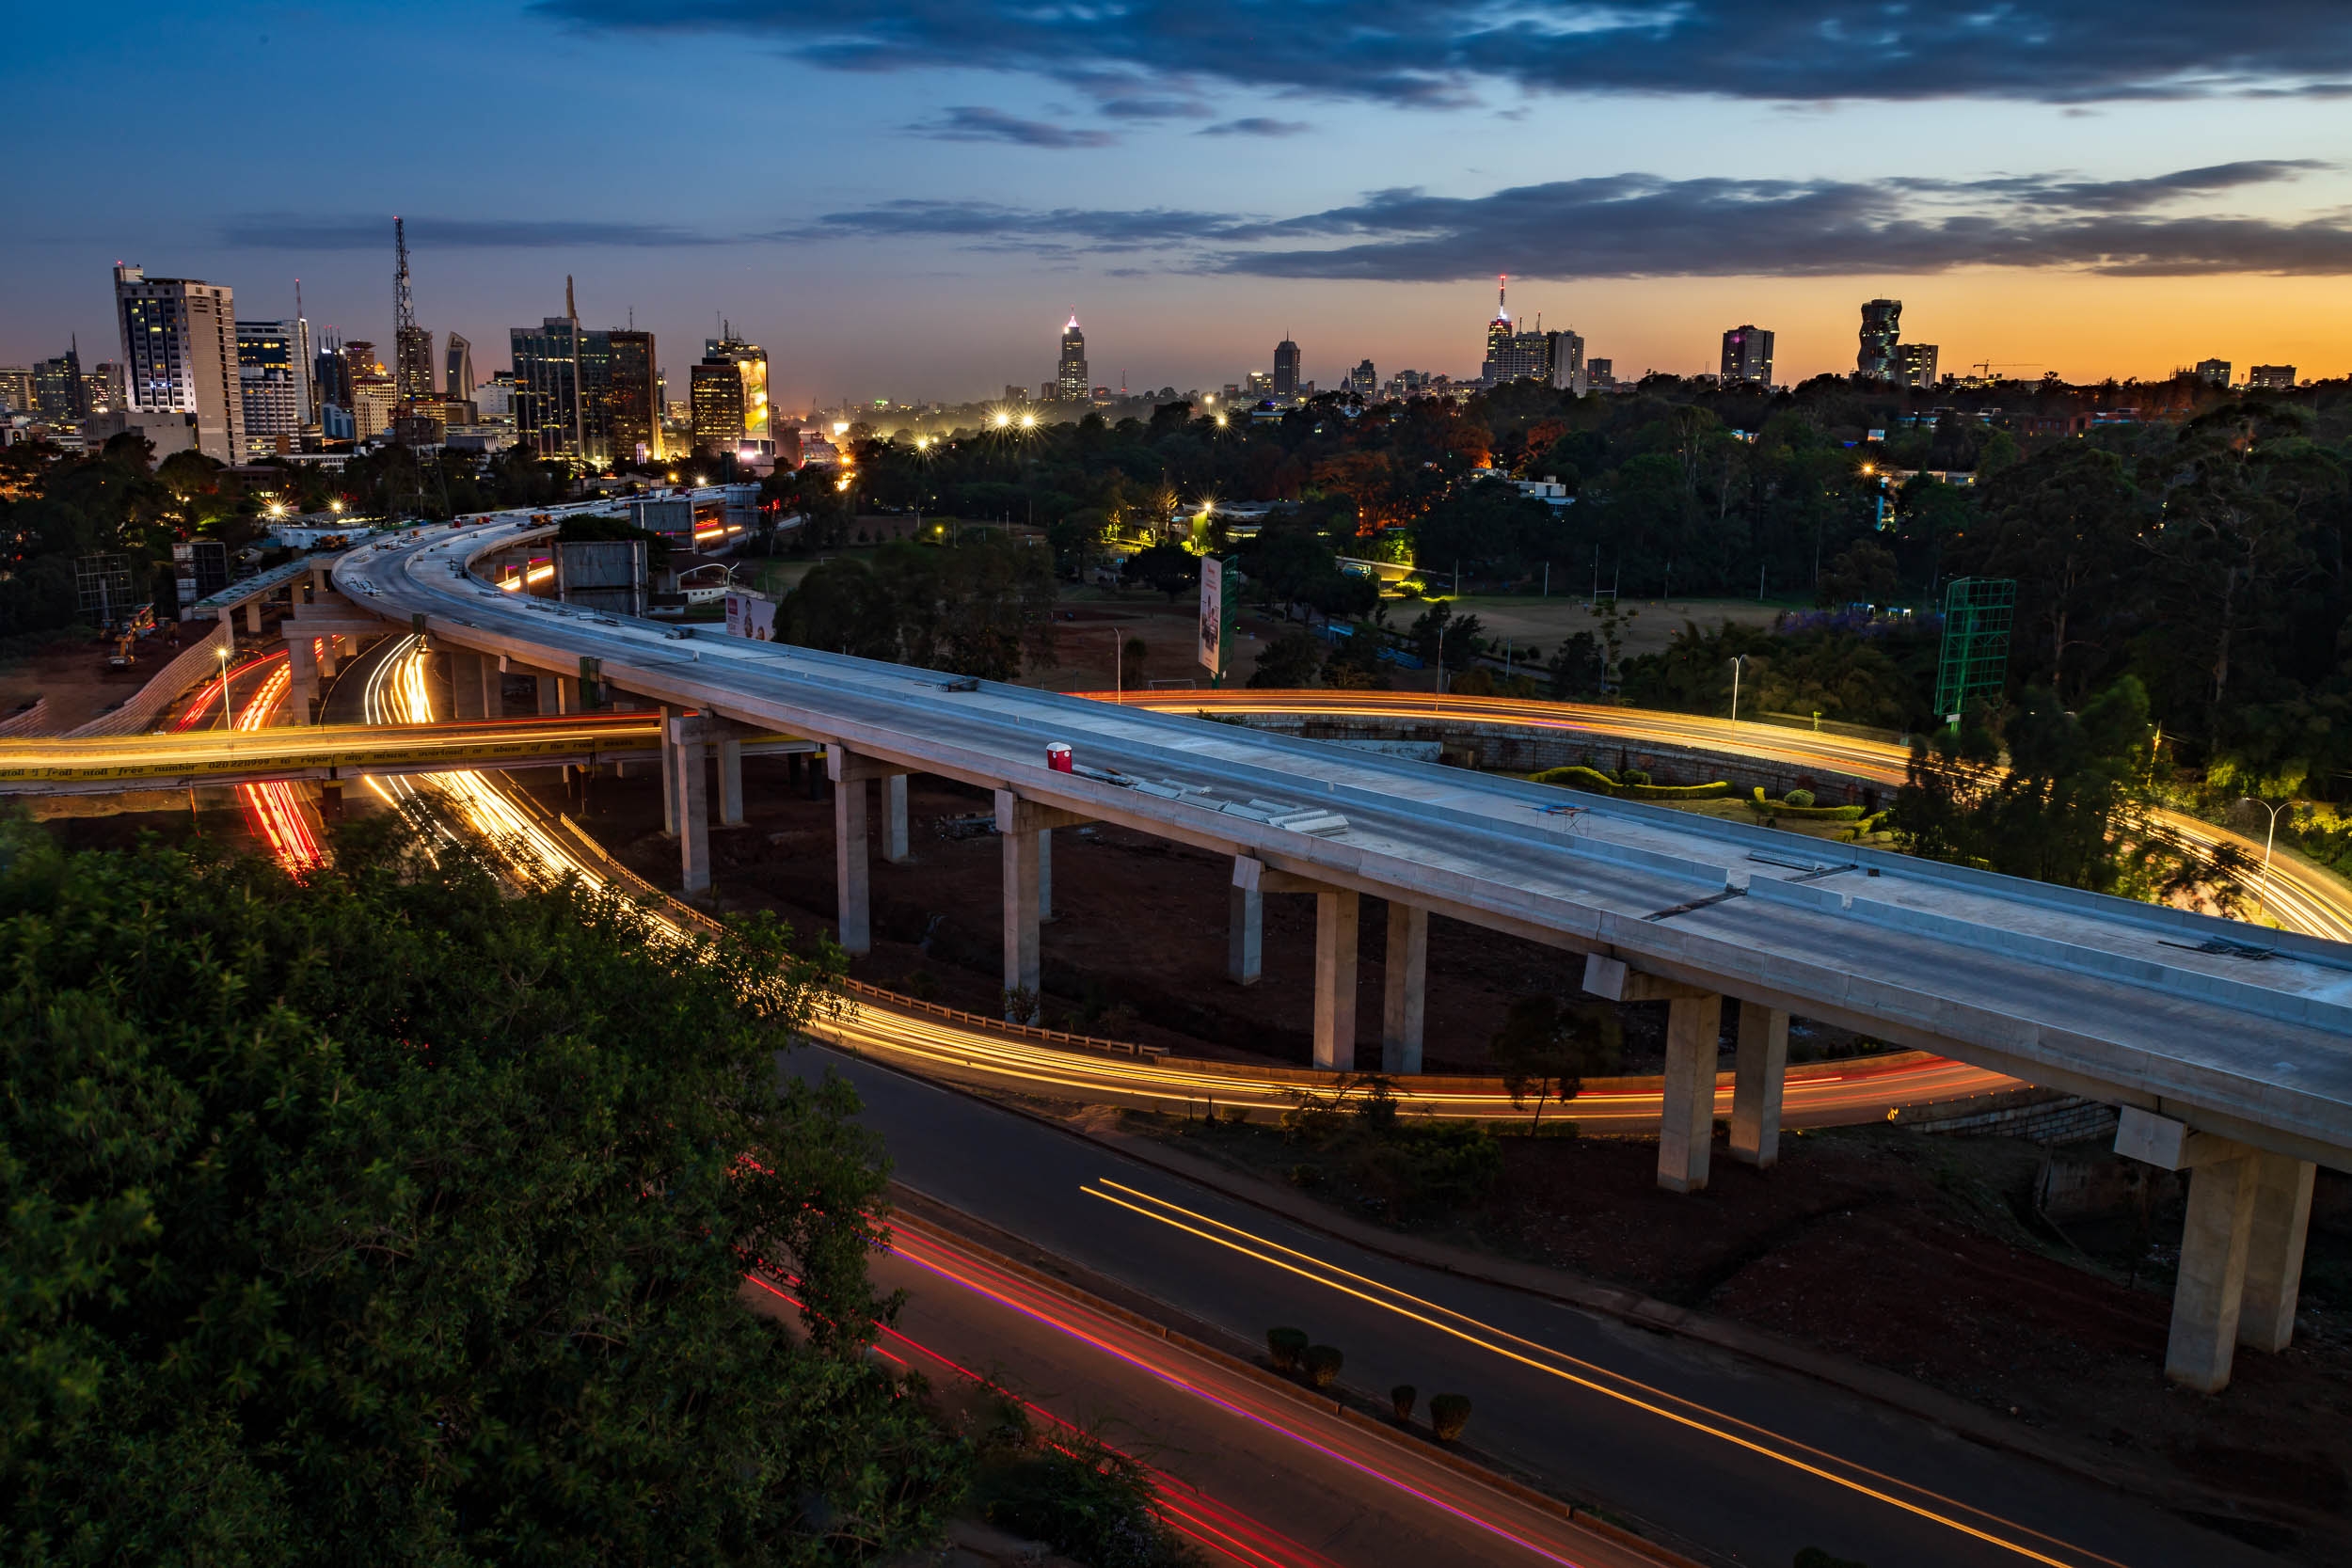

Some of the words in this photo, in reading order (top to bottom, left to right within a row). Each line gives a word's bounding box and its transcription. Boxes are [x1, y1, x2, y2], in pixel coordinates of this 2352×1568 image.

[118, 767, 143, 776] free
[154, 764, 198, 772] number
[531, 743, 543, 752] of
